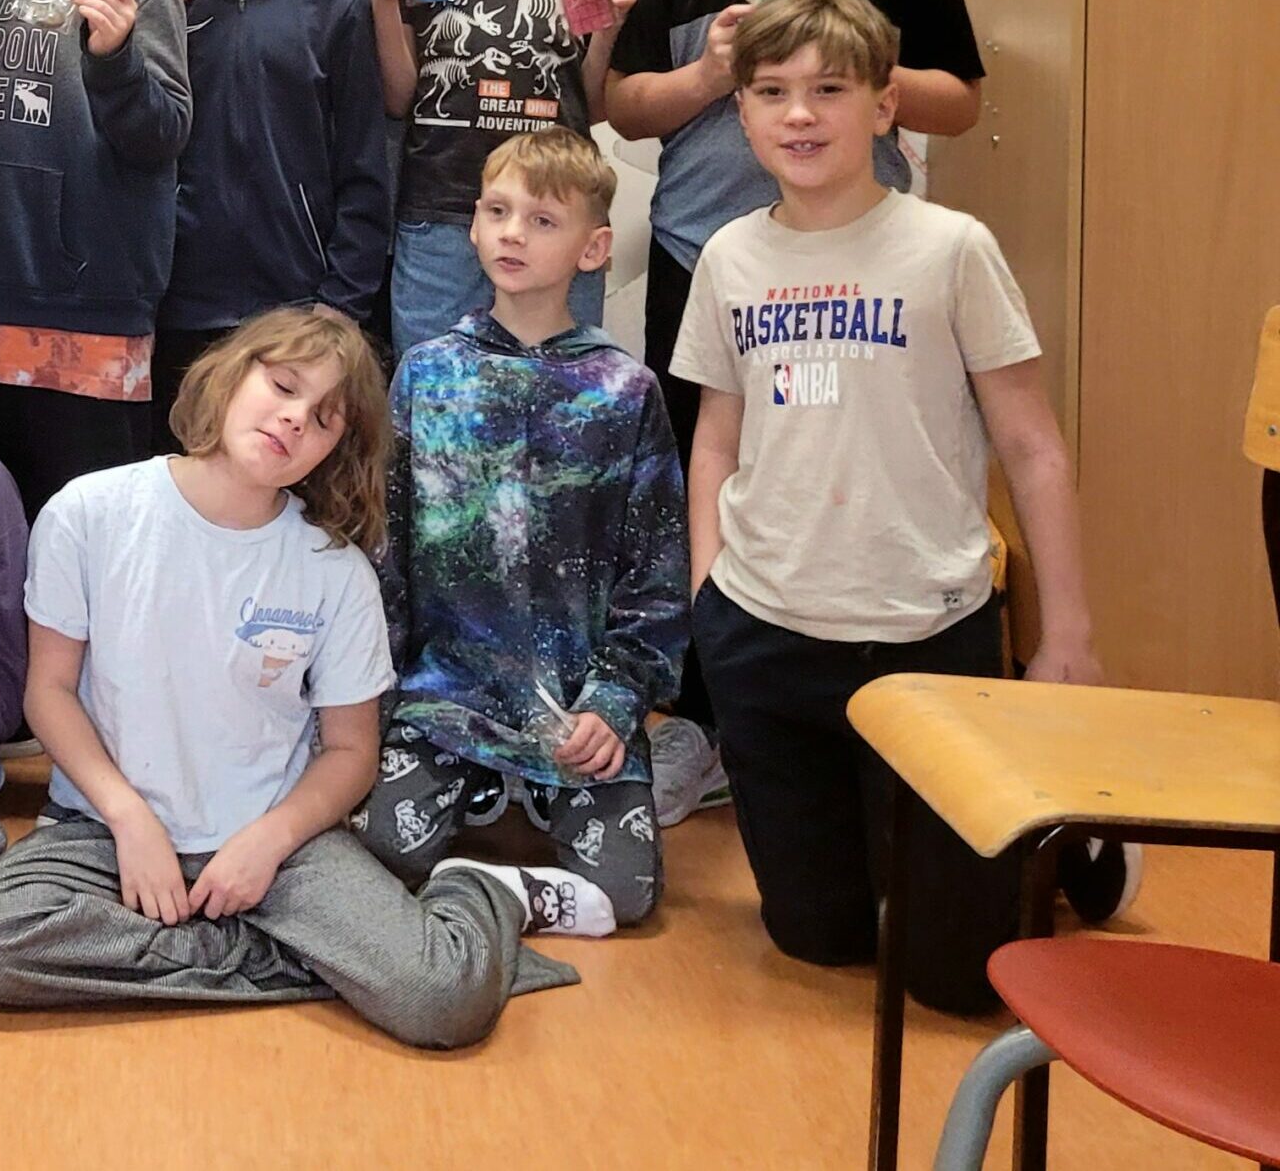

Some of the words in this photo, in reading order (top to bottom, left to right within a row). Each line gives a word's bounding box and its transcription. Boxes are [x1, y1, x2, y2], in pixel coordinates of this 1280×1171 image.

[482, 81, 507, 95] THE
[479, 98, 524, 113] GREAT
[526, 102, 558, 117] DINO
[767, 283, 861, 301] NATIONAL
[731, 298, 907, 357] BASKETBALL
[791, 361, 839, 406] NBA
